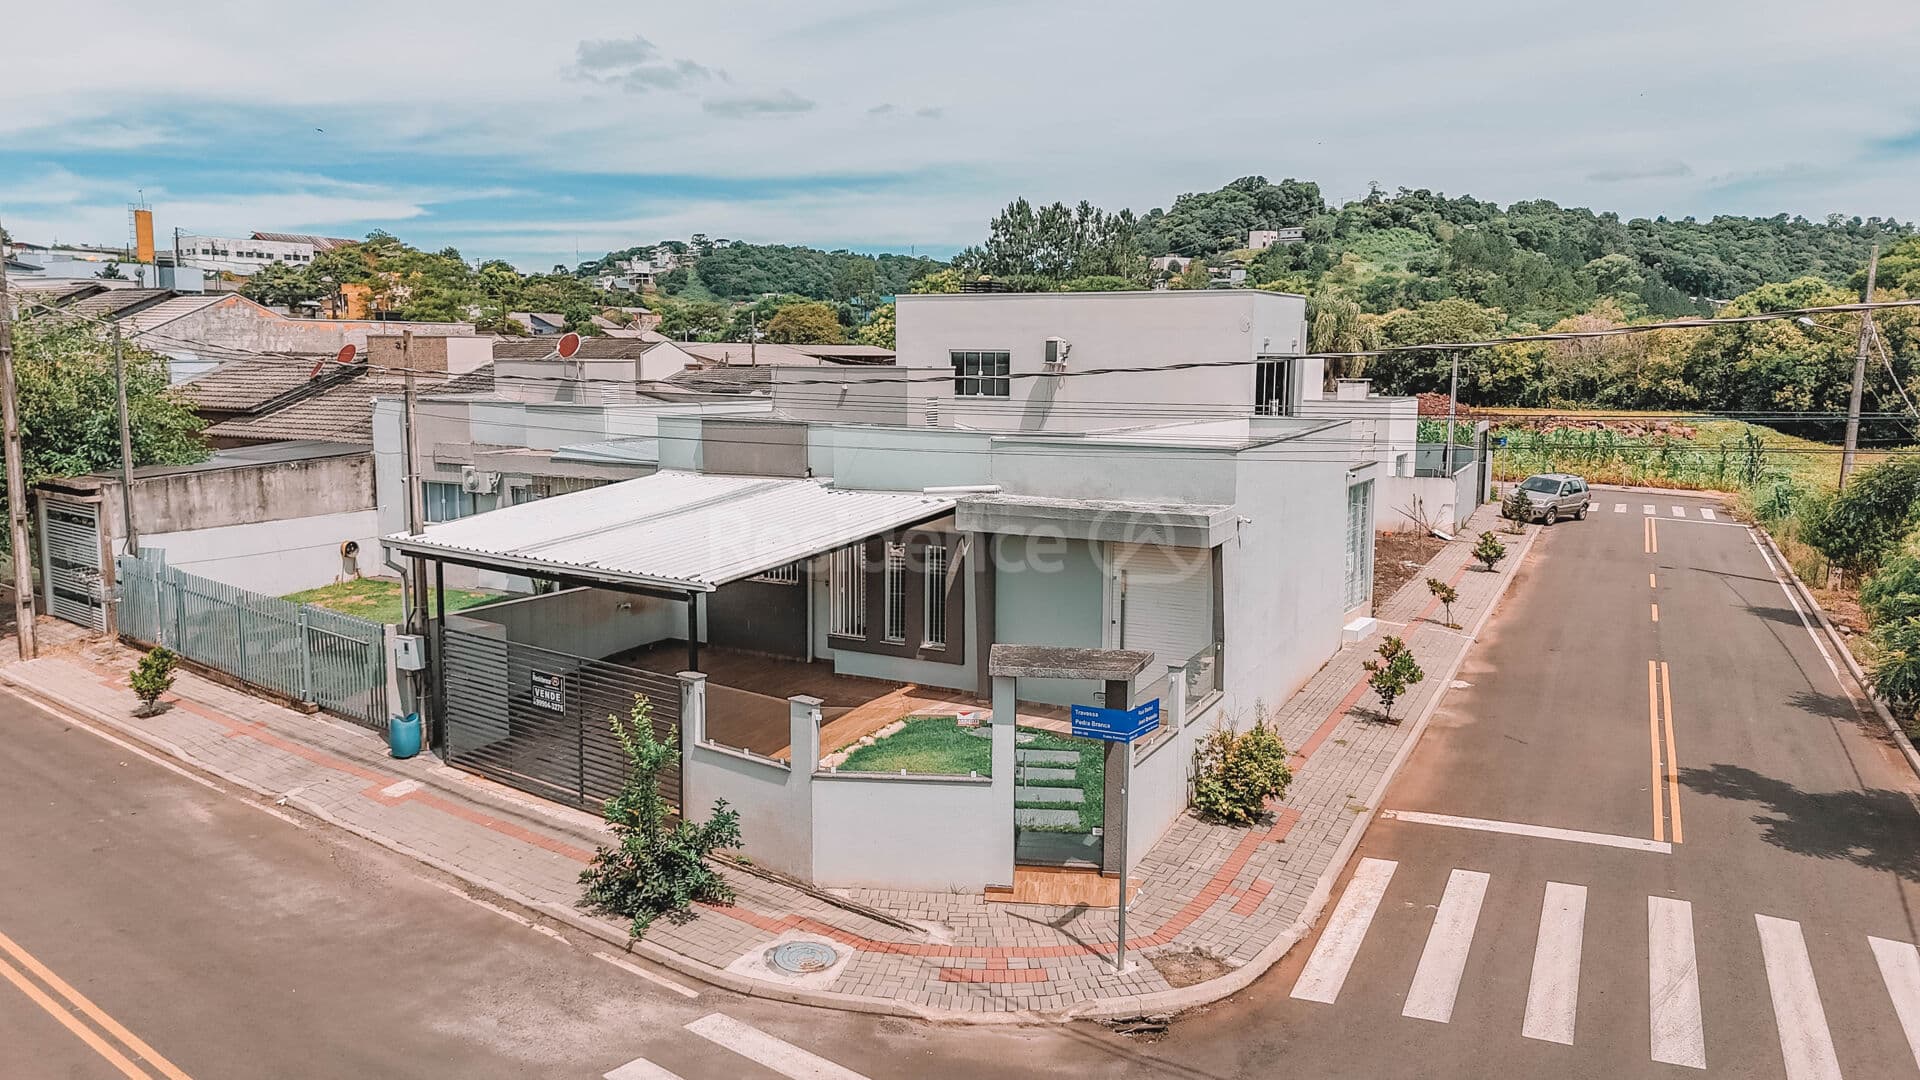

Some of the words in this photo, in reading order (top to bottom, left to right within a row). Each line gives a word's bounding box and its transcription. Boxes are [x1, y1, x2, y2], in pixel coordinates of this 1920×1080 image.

[534, 687, 561, 702] VENDE
[1074, 709, 1099, 718] Travessa
[1074, 718, 1091, 726] Pedra
[1091, 720, 1111, 729] Branca
